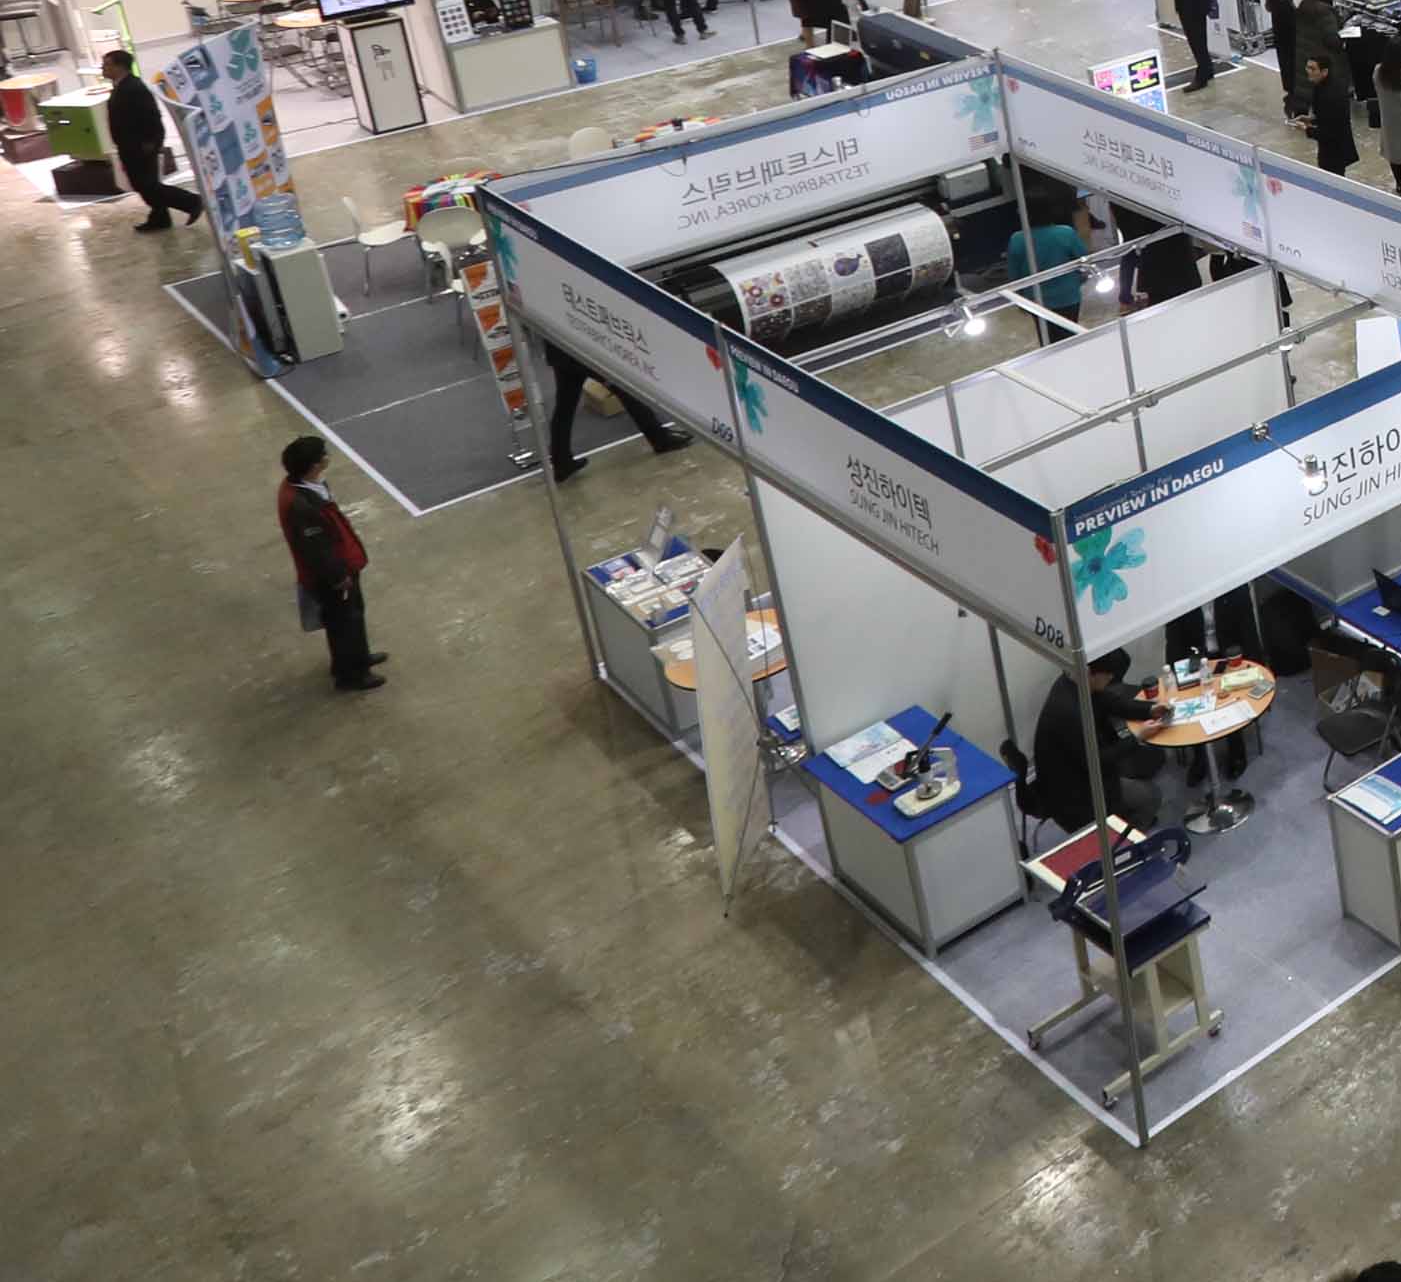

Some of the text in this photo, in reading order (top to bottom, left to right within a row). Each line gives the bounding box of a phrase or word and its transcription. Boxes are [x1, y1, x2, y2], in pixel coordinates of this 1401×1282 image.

[711, 417, 733, 442] D09
[845, 454, 932, 525] 성진하이텍
[1074, 459, 1224, 536] PREVIEW IN DAEGU
[1302, 489, 1347, 526] SUNG
[1350, 475, 1379, 510] JIN
[848, 489, 939, 556] SUNG JIN HITECH
[1034, 615, 1065, 649] D08
